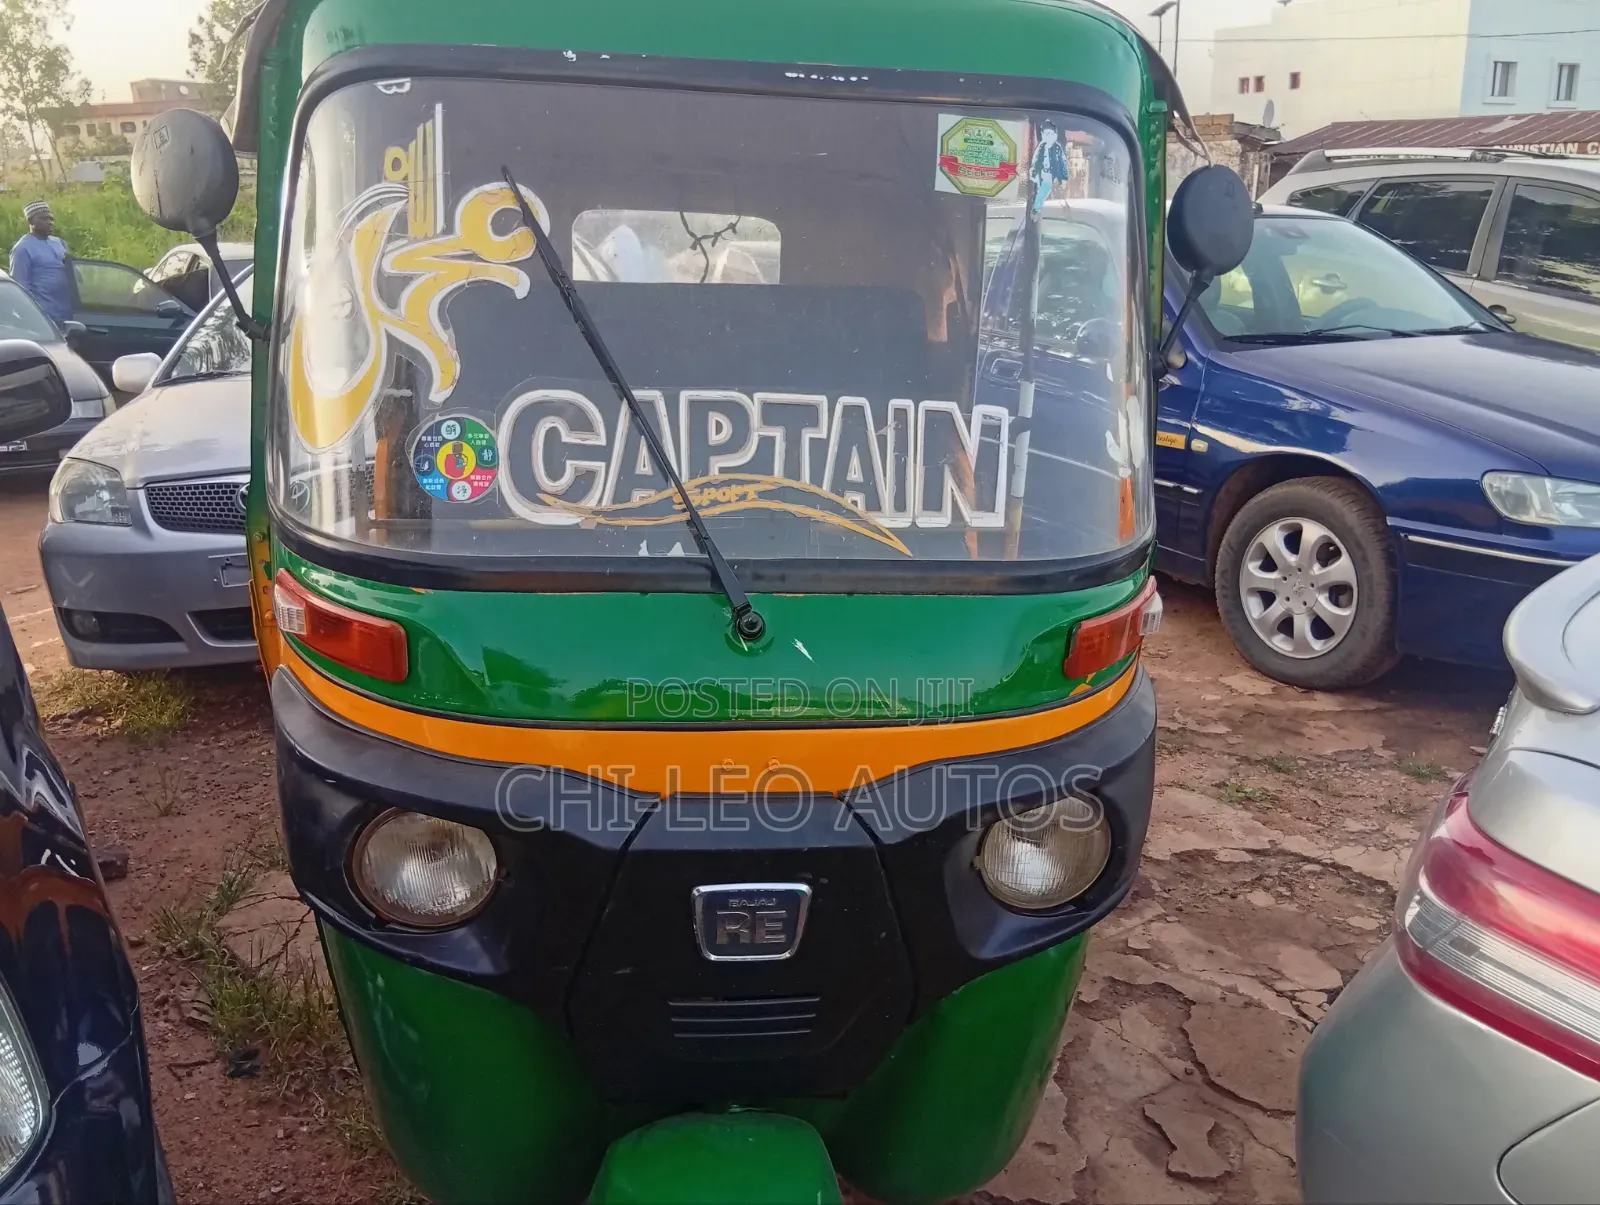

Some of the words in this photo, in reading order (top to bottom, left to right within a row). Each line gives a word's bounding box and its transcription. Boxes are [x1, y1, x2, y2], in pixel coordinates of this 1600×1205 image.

[1586, 141, 1600, 154] C
[1157, 435, 1177, 446] restige
[499, 388, 1009, 528] CAPTAIN
[715, 910, 787, 945] RE
